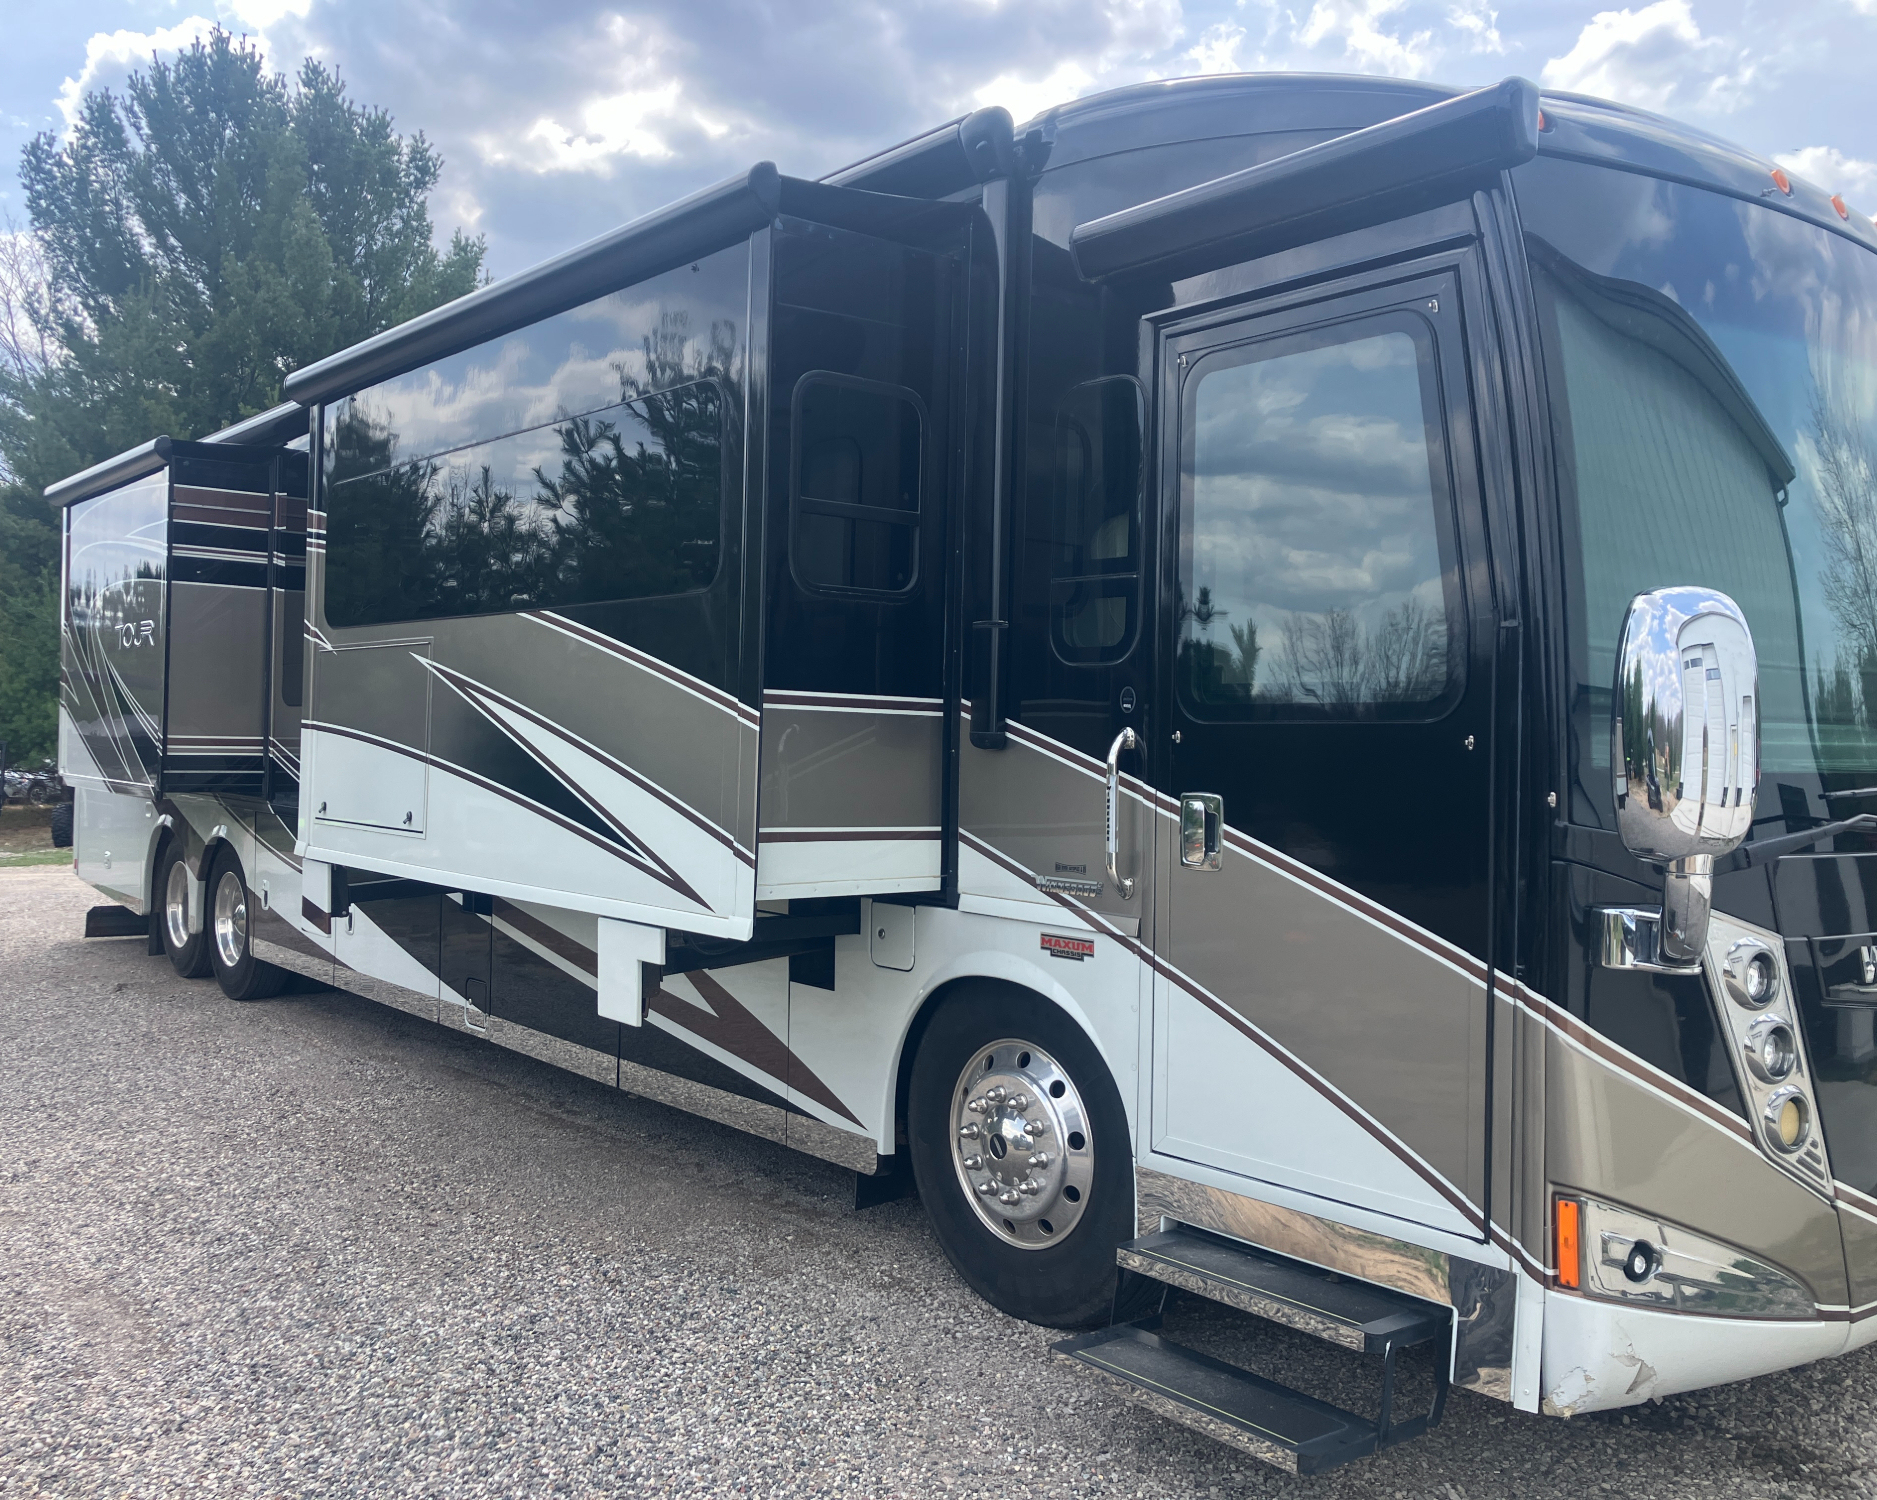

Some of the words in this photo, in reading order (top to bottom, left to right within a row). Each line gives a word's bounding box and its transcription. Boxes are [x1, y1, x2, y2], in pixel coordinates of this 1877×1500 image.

[115, 619, 155, 650] TOUR
[1041, 936, 1094, 954] MAXUM
[1052, 948, 1082, 958] CHASSIS
